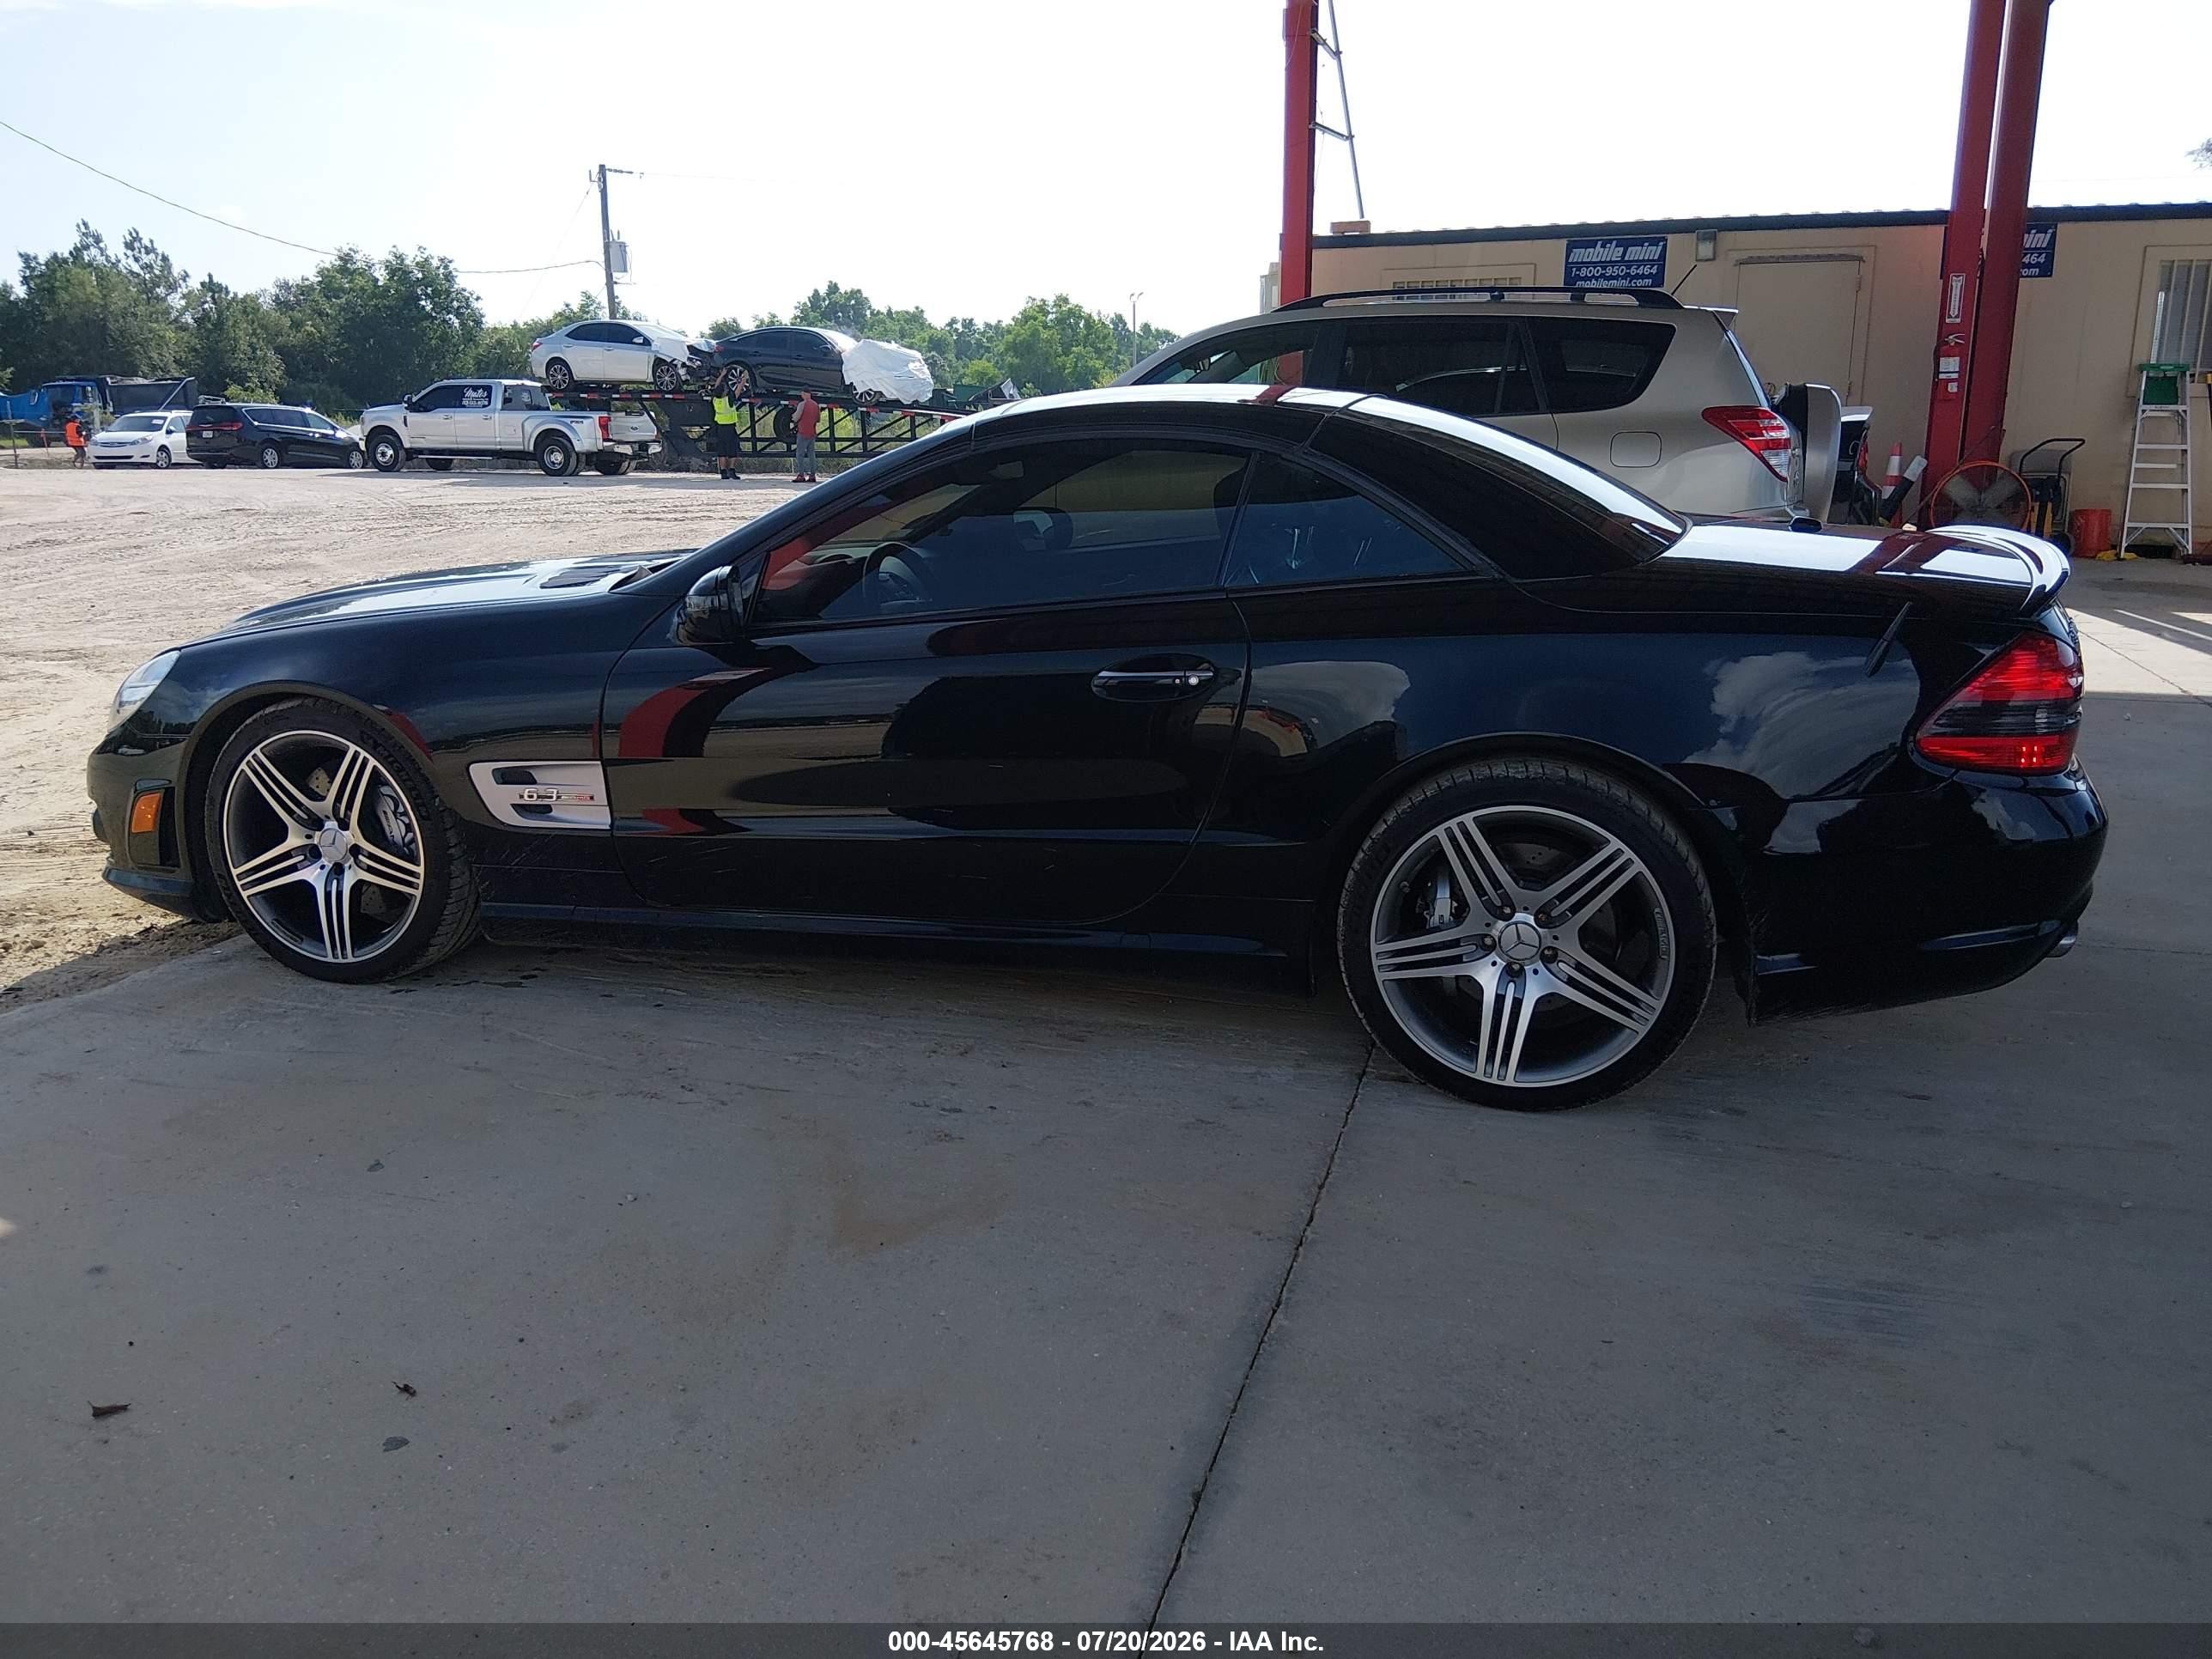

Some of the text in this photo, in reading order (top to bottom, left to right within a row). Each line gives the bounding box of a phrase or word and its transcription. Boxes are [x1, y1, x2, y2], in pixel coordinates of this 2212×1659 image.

[1568, 240, 1663, 262] mobile mini
[1571, 264, 1658, 277] 1-800-950-6464
[1576, 277, 1652, 288] mobilemini.com
